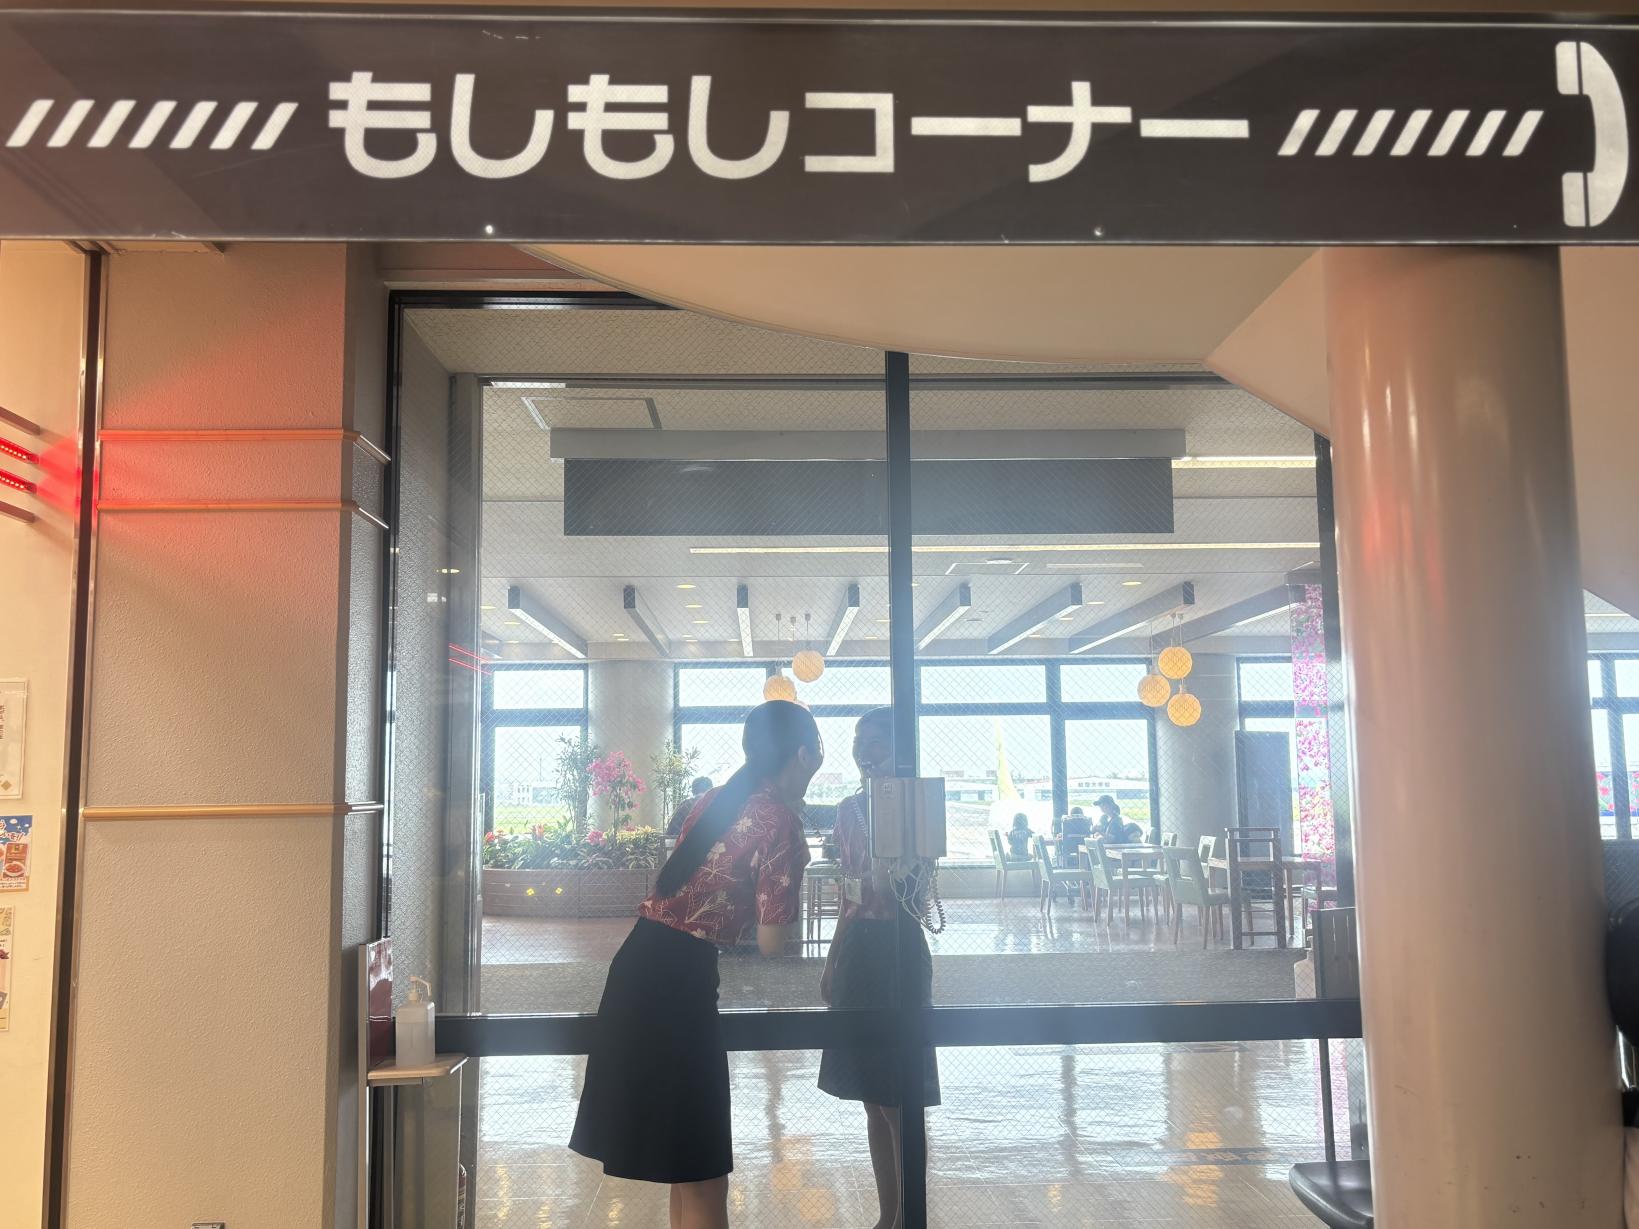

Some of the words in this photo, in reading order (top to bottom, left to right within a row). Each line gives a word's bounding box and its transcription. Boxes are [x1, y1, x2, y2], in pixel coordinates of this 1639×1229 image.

[328, 71, 1250, 182] もしもしコーナー
